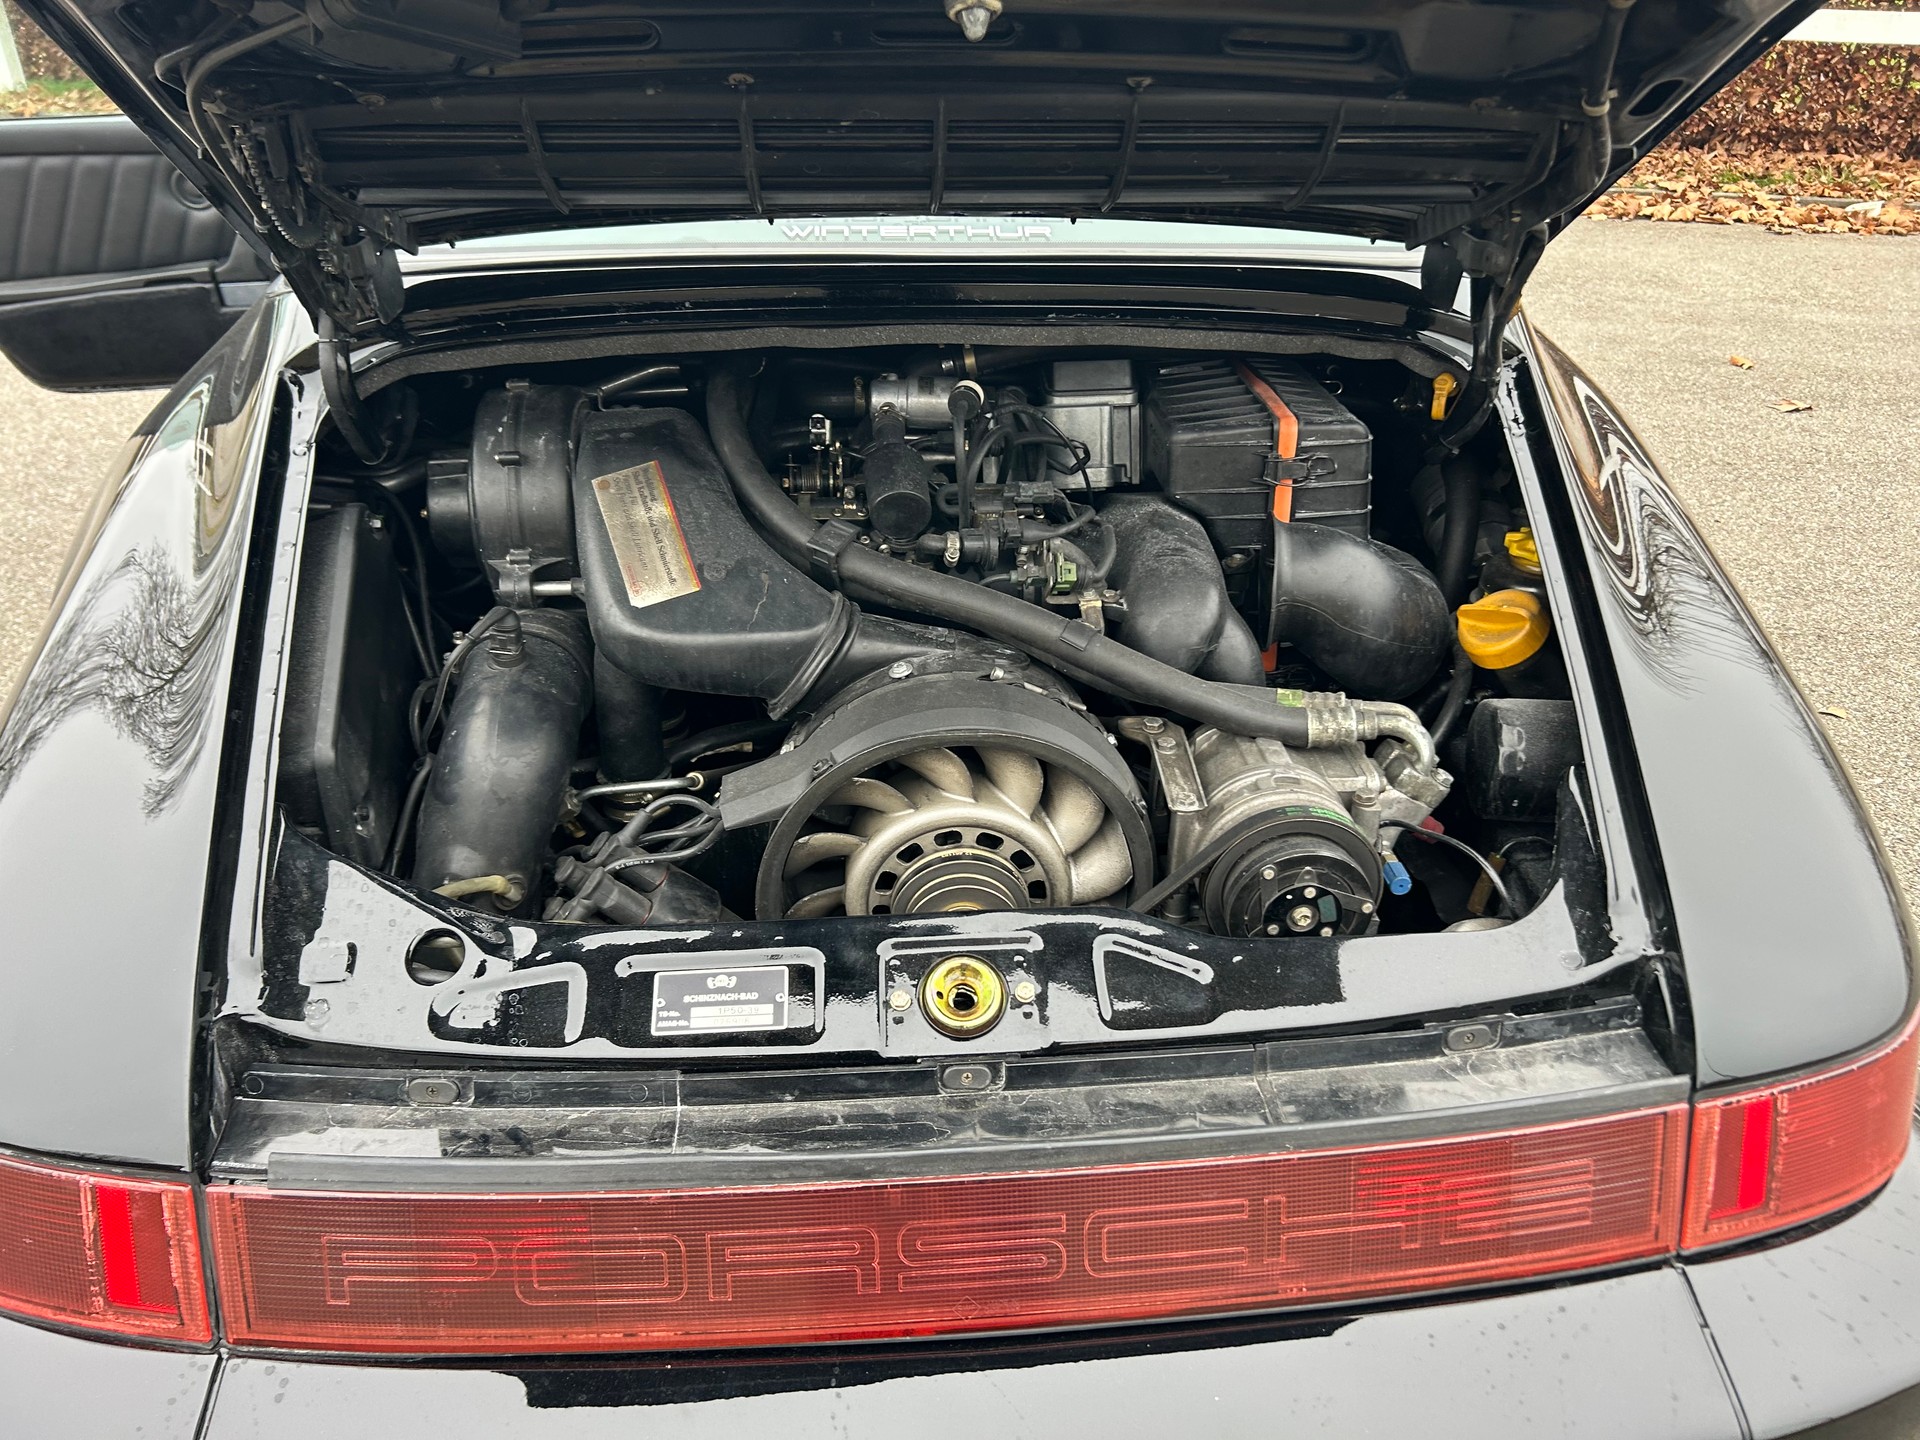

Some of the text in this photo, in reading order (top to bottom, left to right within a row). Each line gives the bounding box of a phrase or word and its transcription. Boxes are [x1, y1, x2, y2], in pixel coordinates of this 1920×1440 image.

[781, 225, 1053, 239] WINTERTHUR
[634, 470, 642, 486] Shell
[638, 486, 652, 515] Kraftstoffe
[647, 515, 657, 528] und
[652, 528, 662, 545] Shell
[628, 520, 638, 538] Shell
[683, 992, 759, 1003] SCHINZNACH-BAD
[321, 1158, 1595, 1306] PORSCHE
